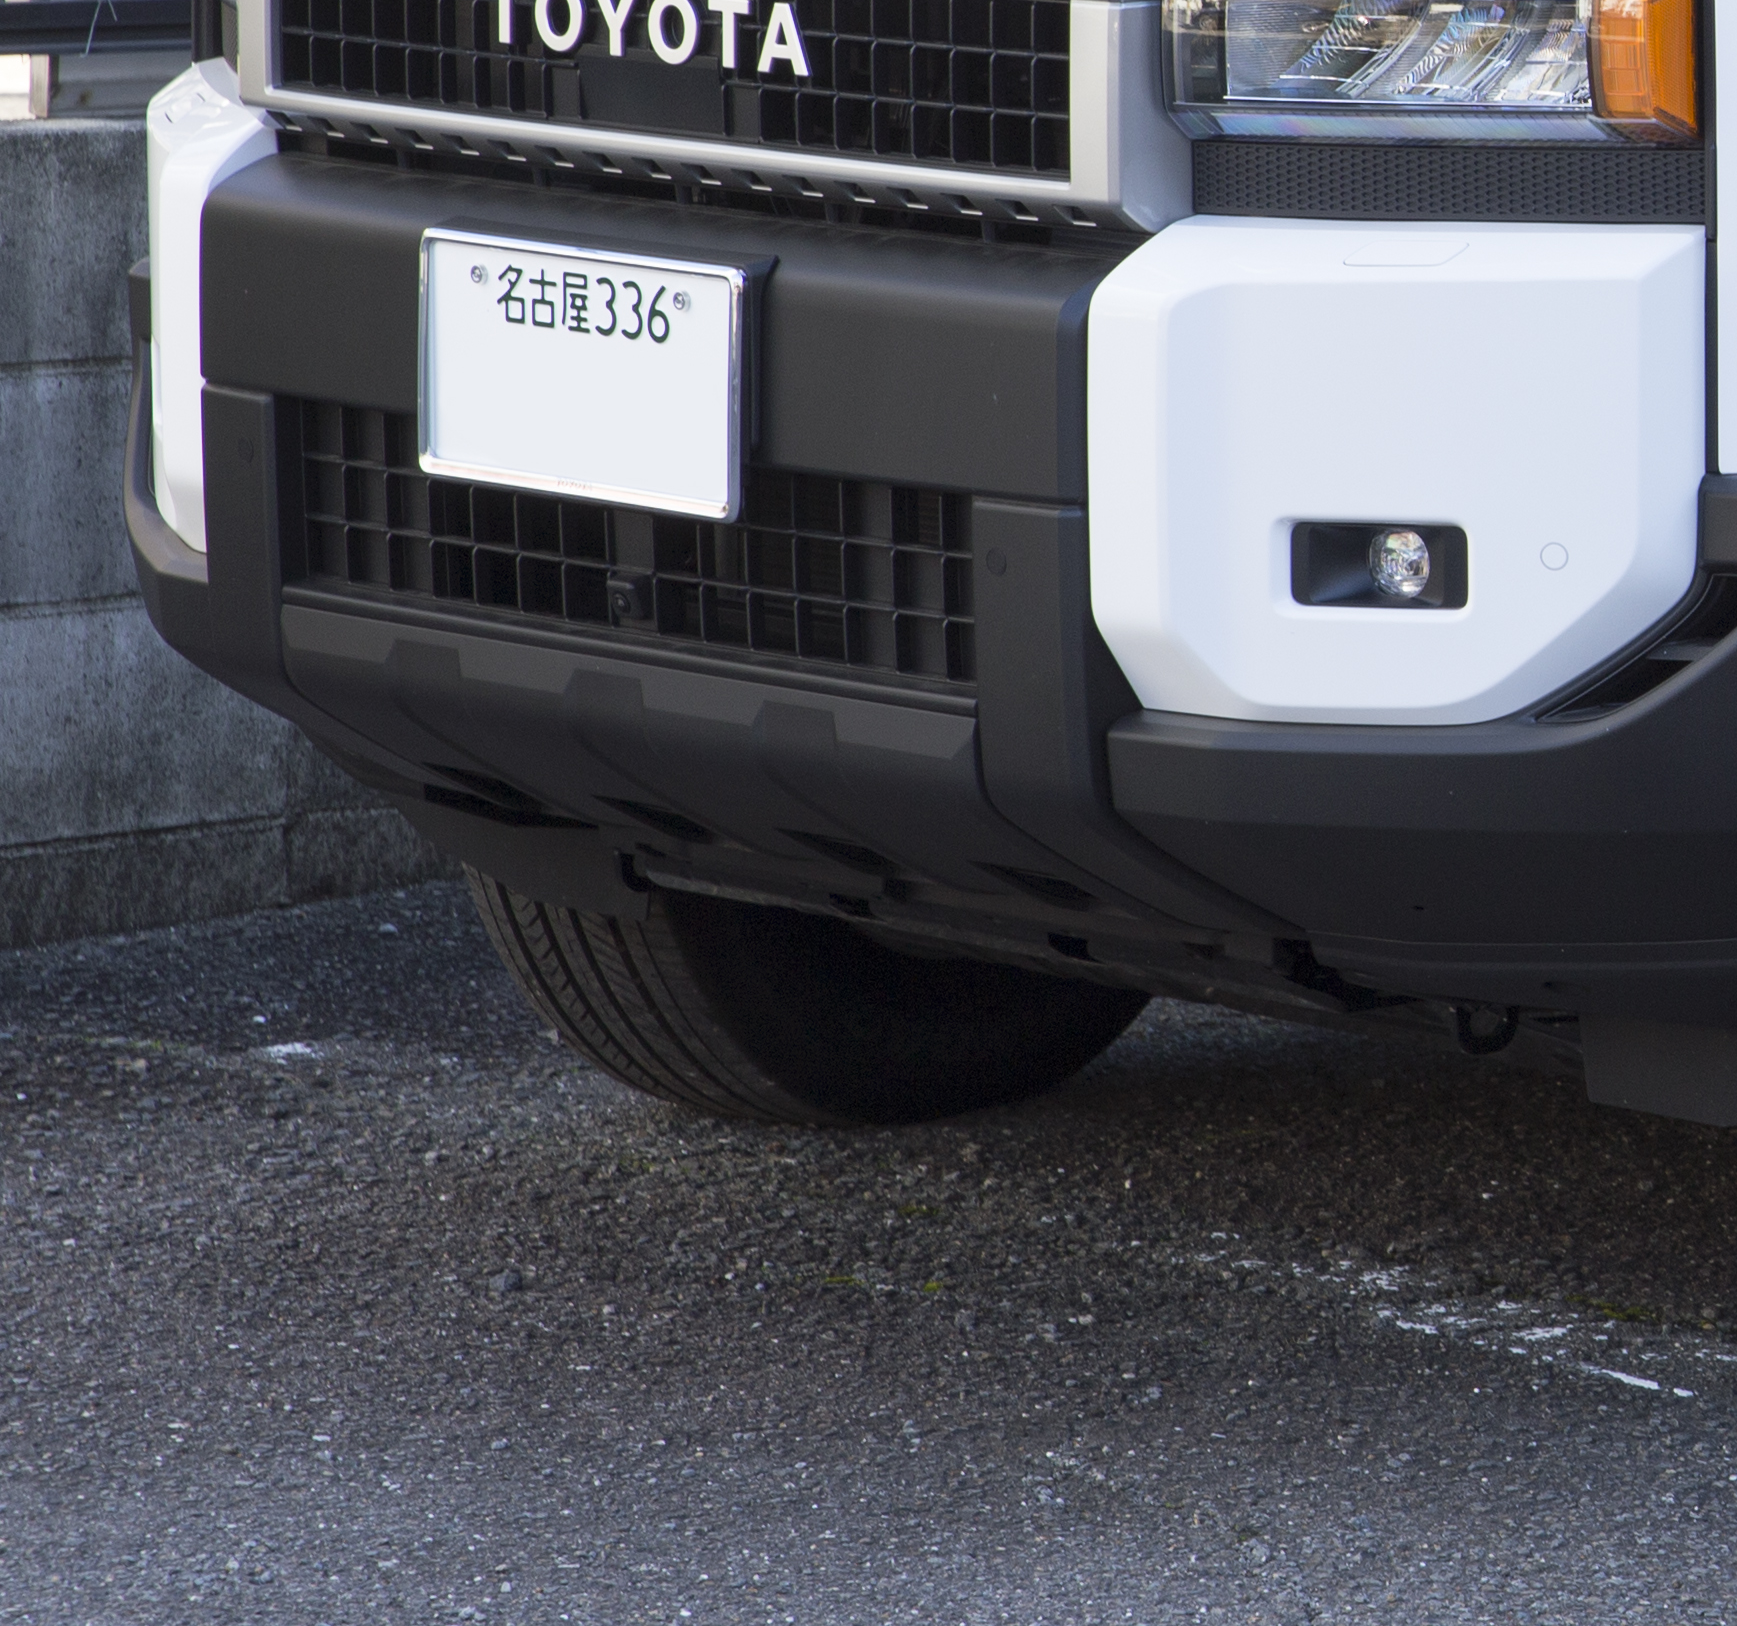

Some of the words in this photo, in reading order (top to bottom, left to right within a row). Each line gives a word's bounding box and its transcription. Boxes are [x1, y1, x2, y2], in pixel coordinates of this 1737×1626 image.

[497, 264, 591, 334] 名古屋
[595, 277, 670, 344] 336
